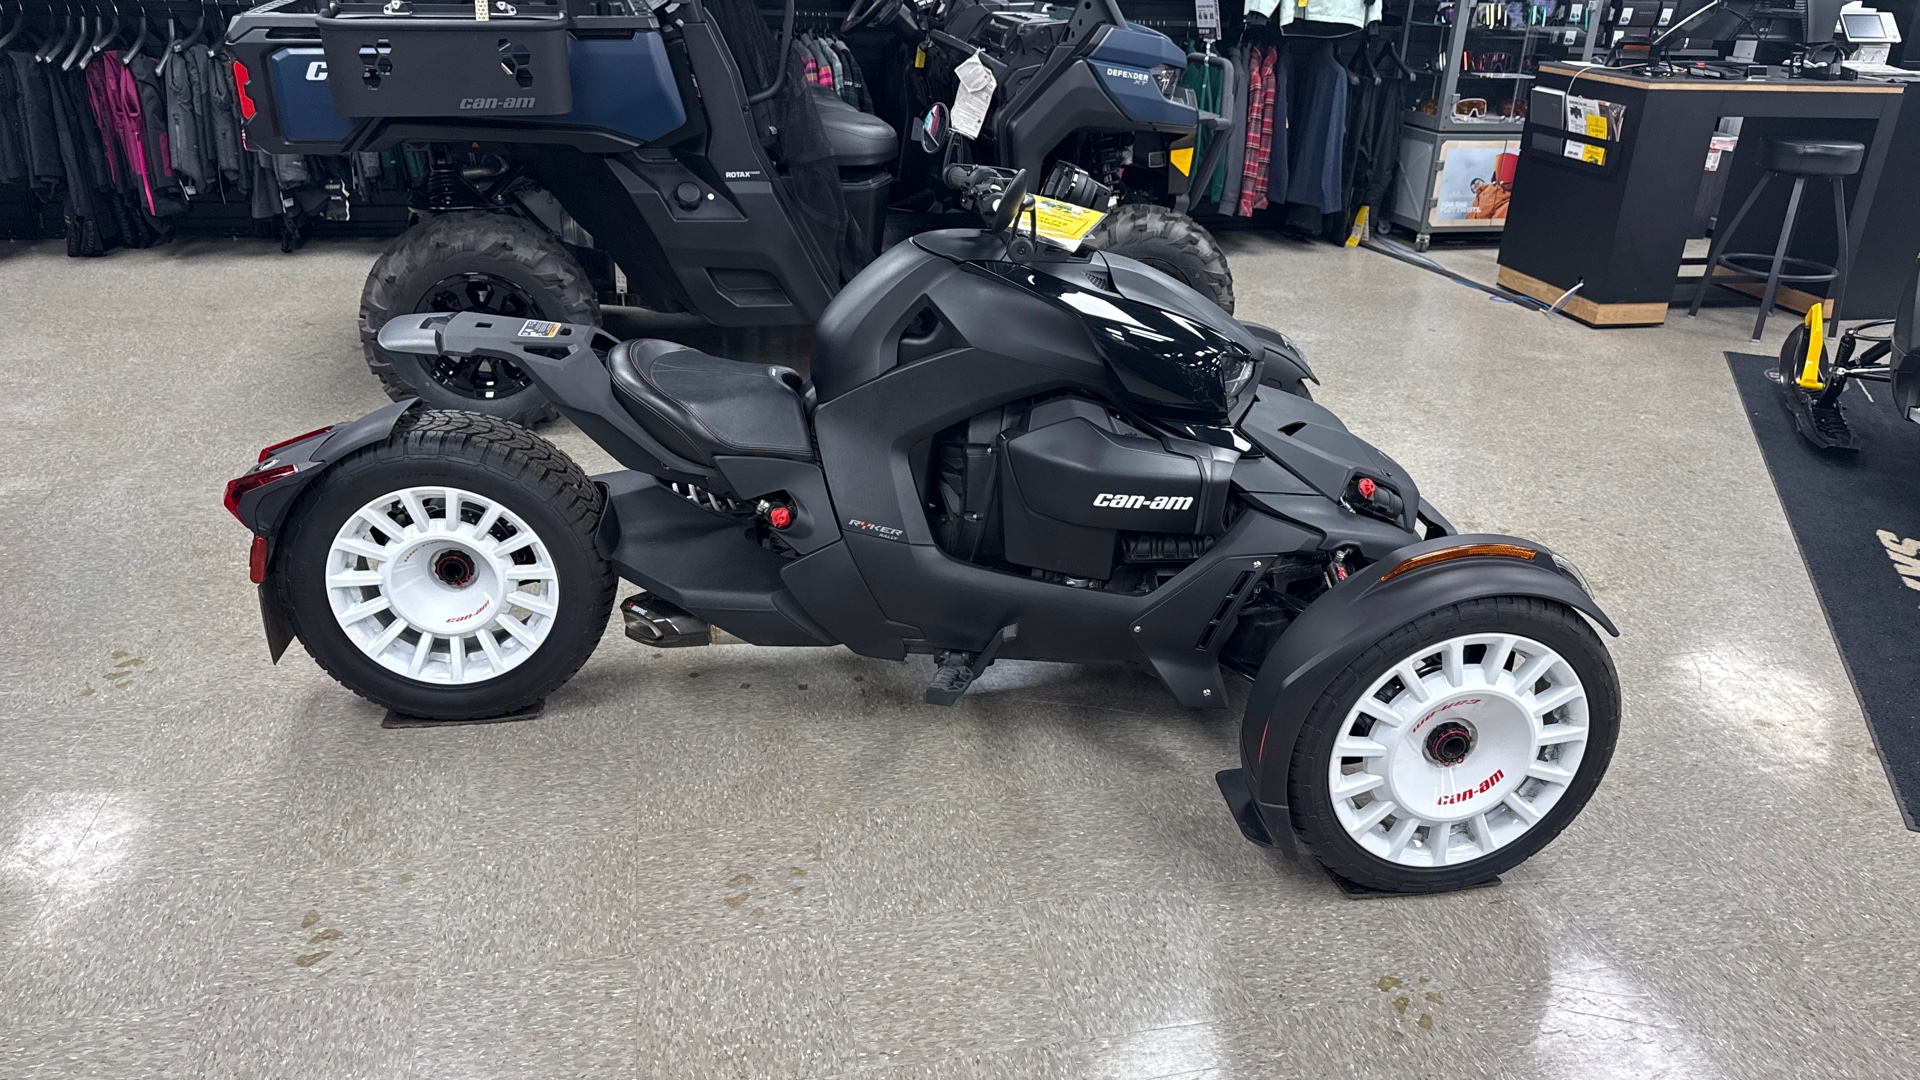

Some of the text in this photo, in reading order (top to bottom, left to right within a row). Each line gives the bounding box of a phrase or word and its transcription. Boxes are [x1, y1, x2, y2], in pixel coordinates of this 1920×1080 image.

[1106, 68, 1149, 81] DEFENDER
[459, 97, 536, 109] can-am
[725, 171, 751, 179] ROTAX
[1093, 493, 1194, 510] can-am
[848, 519, 903, 536] RYKER
[878, 533, 899, 541] RALLY
[445, 599, 490, 623] can-am
